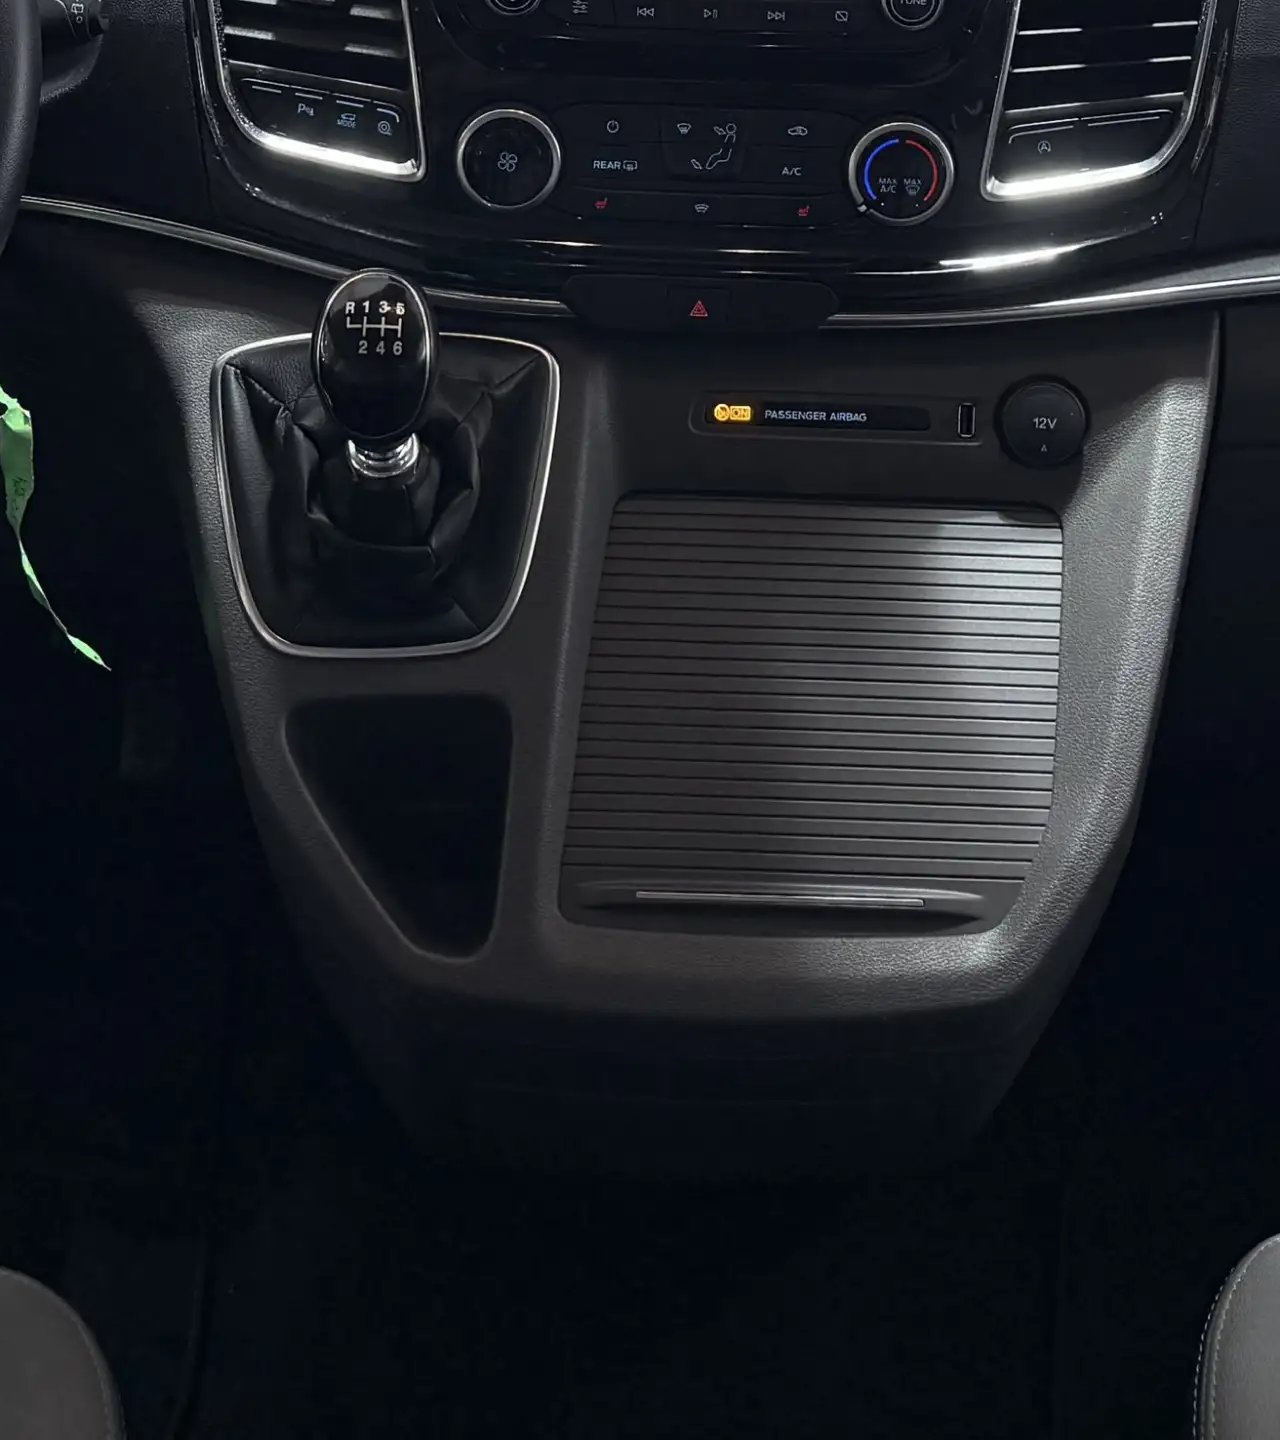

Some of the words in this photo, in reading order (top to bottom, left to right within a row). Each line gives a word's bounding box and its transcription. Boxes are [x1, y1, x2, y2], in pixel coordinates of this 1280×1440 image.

[336, 118, 357, 129] MODE
[593, 160, 621, 170] REAR
[781, 167, 803, 176] A/C
[878, 177, 898, 185] MAX
[903, 178, 922, 186] MAX
[880, 184, 897, 194] A/C
[345, 301, 356, 315] R
[362, 300, 370, 313] 1
[379, 300, 389, 313] 3
[358, 340, 368, 354] 2
[376, 340, 386, 355] 4
[393, 341, 403, 356] 6
[764, 409, 827, 422] PASSENGER
[829, 411, 868, 423] AIRBAG
[1032, 416, 1057, 430] 12V
